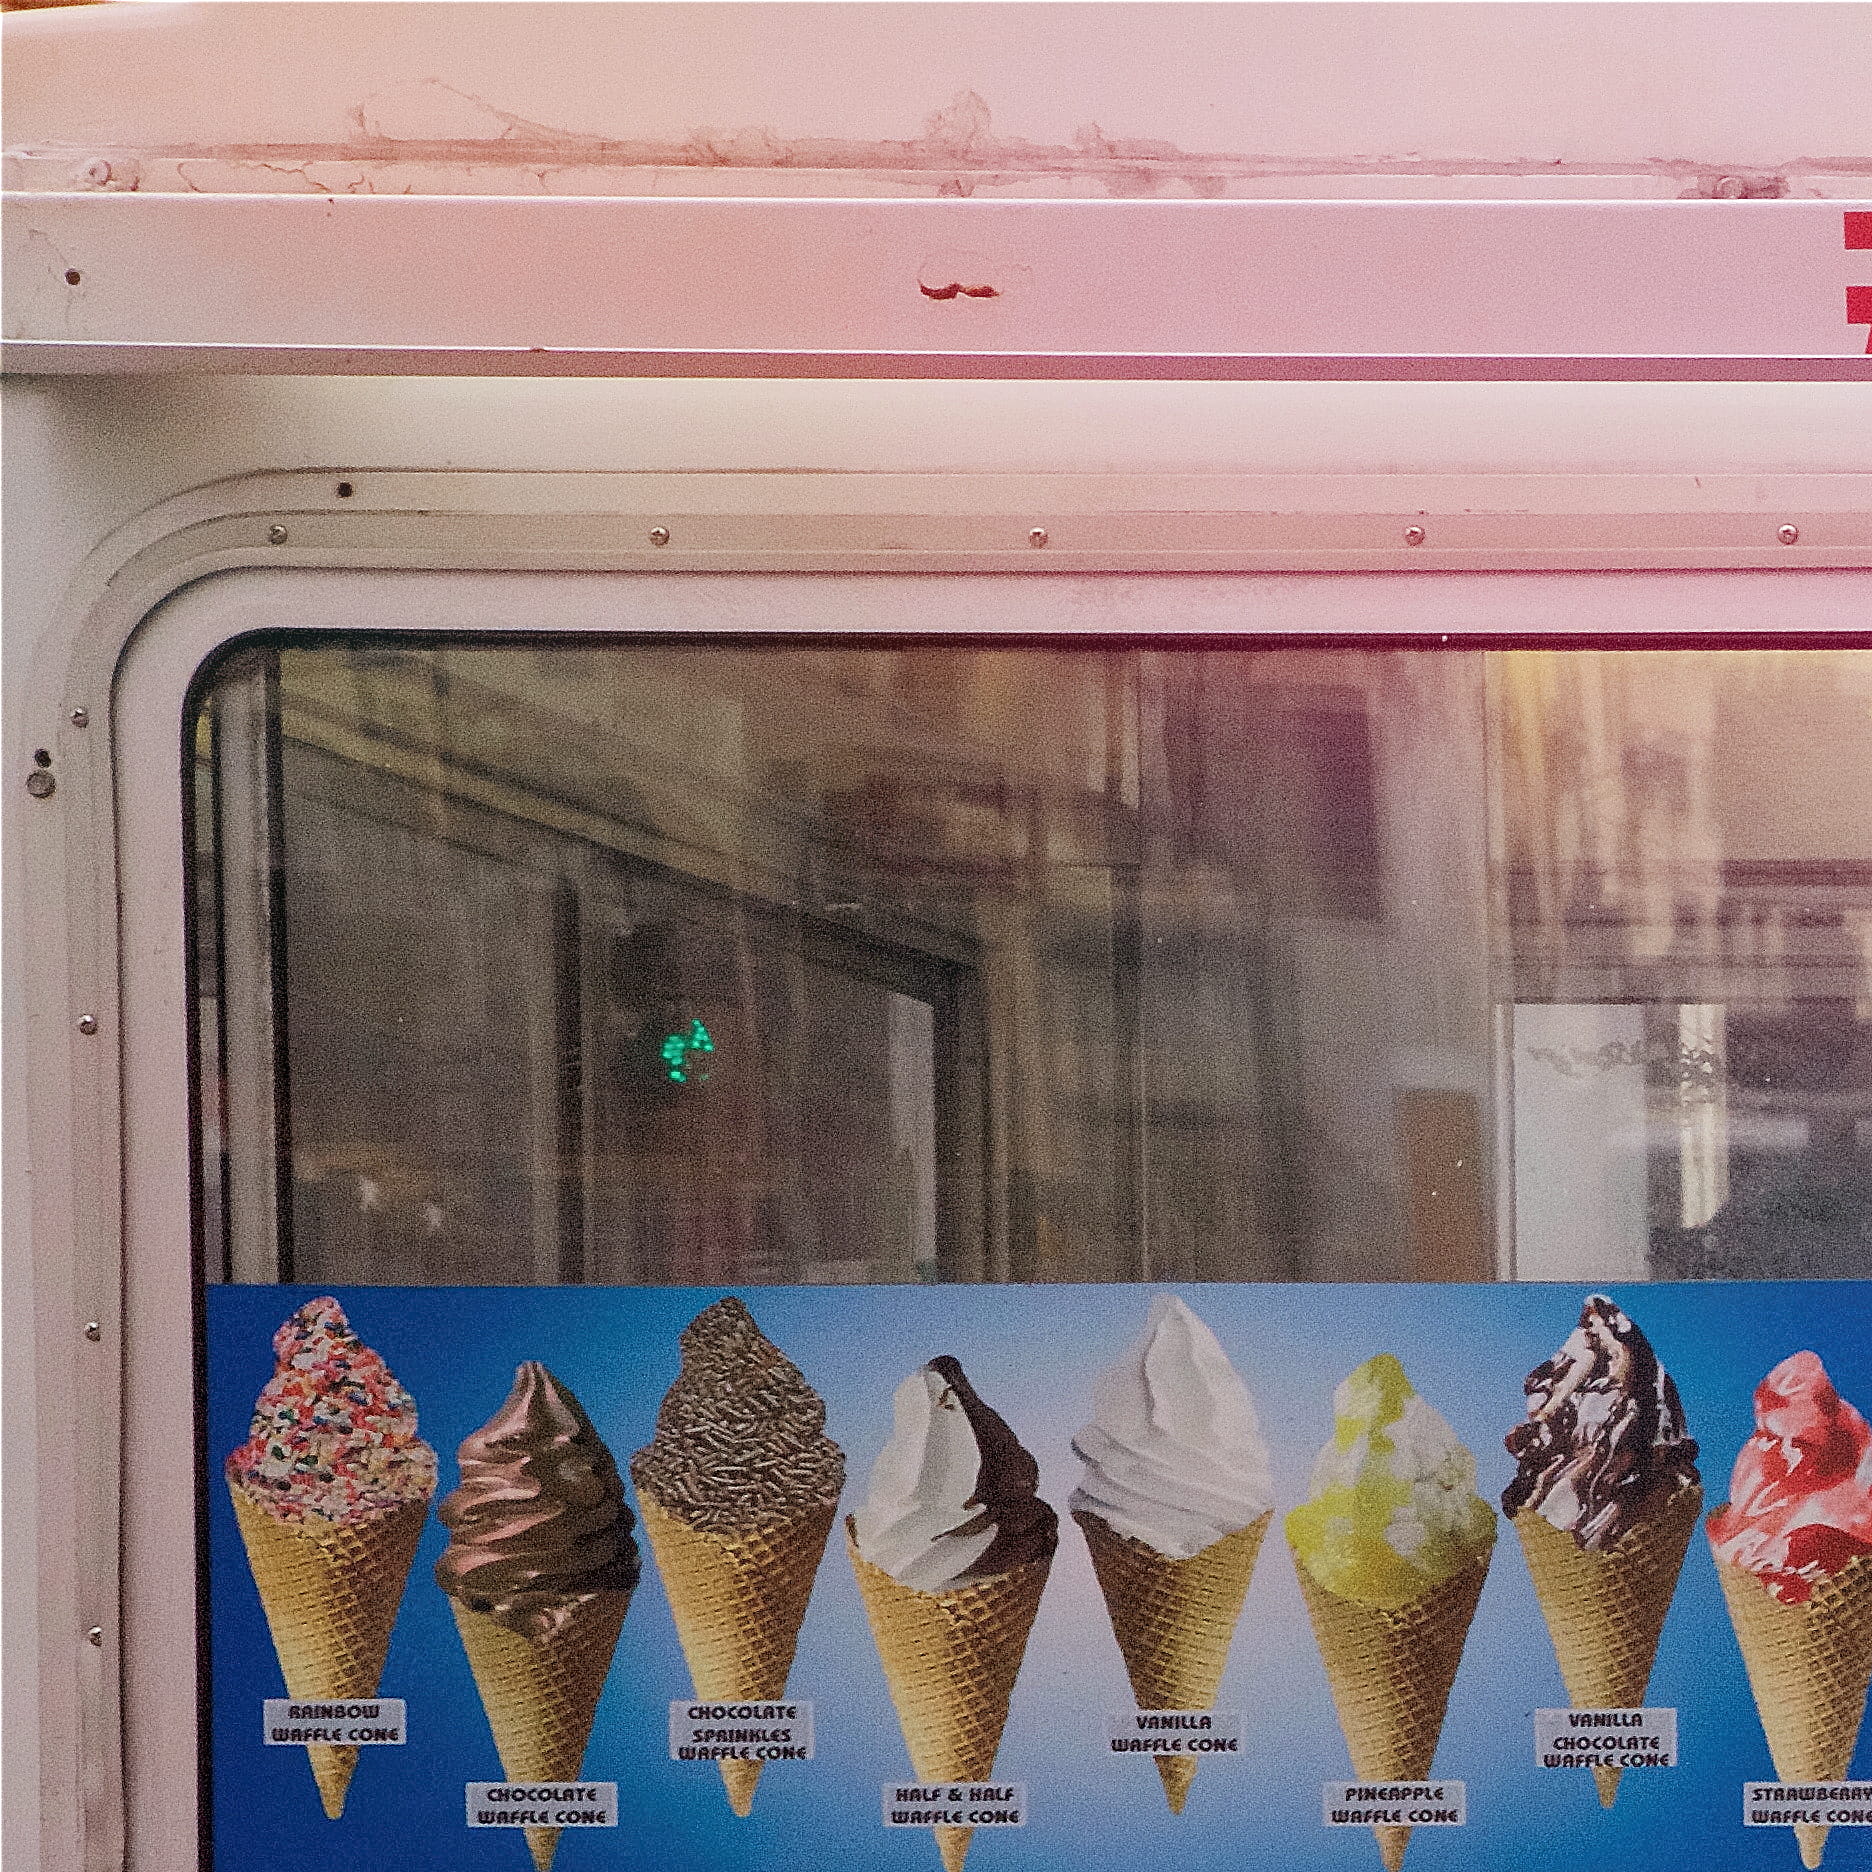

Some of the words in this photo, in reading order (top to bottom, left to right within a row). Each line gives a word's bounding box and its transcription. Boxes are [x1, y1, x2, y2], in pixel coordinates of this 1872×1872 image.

[287, 1705, 380, 1719] RAINBOW
[1136, 1714, 1212, 1730] VANILLA
[272, 1727, 341, 1743] WAFFLE
[348, 1726, 400, 1743] CONE
[1111, 1736, 1182, 1752] WAFFLE
[1188, 1736, 1239, 1752] CONE
[487, 1787, 597, 1802] CHOCOLATE
[896, 1787, 941, 1803] HALF
[948, 1787, 965, 1803] &
[971, 1787, 1016, 1803] HALF
[1345, 1786, 1444, 1802] PINEAPPLE
[477, 1809, 548, 1826] WAFFLE
[555, 1809, 606, 1826] CONE
[892, 1809, 960, 1826] WAFFLE
[967, 1809, 1021, 1826] CONE
[1332, 1808, 1402, 1824] WAFFLE
[1408, 1808, 1459, 1824] CONE
[1753, 1809, 1822, 1825] WAFFLE
